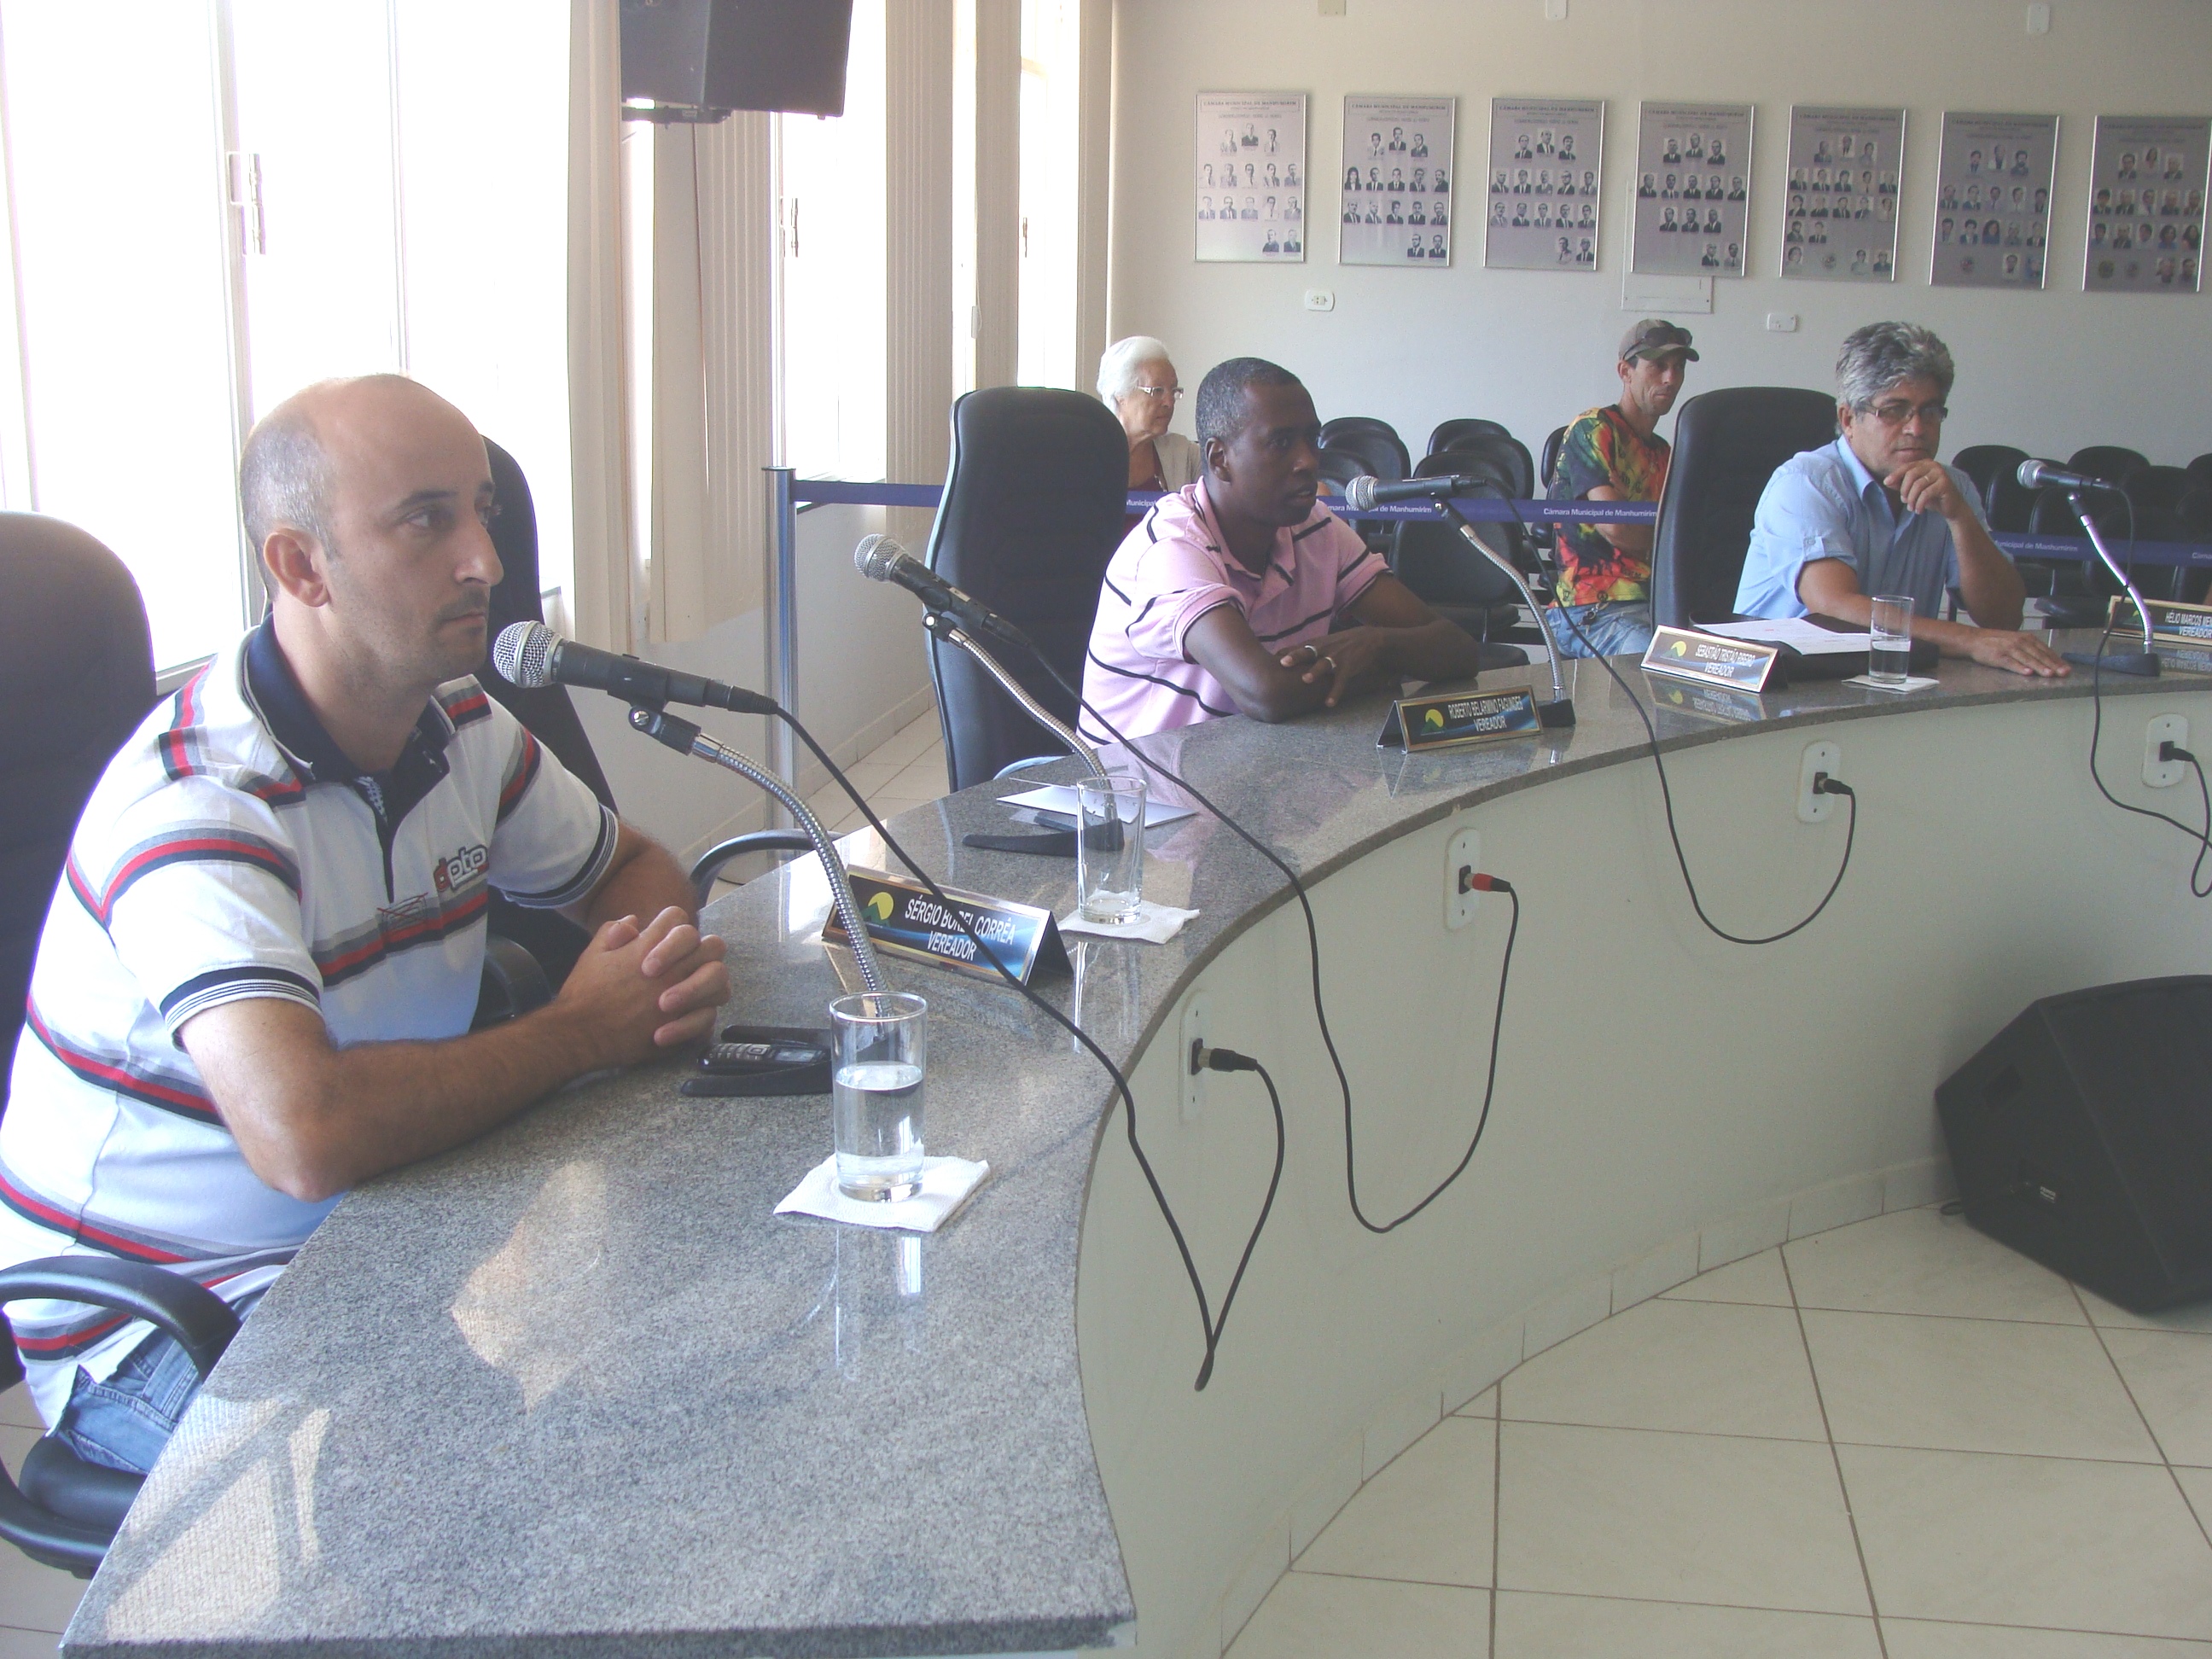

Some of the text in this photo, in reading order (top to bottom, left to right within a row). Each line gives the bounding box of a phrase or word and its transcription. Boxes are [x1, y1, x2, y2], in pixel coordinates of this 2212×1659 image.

[1389, 505, 1432, 514] Manhumirim
[1704, 661, 1735, 678] VEREADOR
[1473, 715, 1507, 731] VEREADOR
[905, 894, 943, 926] SÉRGIO
[974, 916, 1016, 946] CORRÊA
[927, 930, 977, 961] VEREADOR
